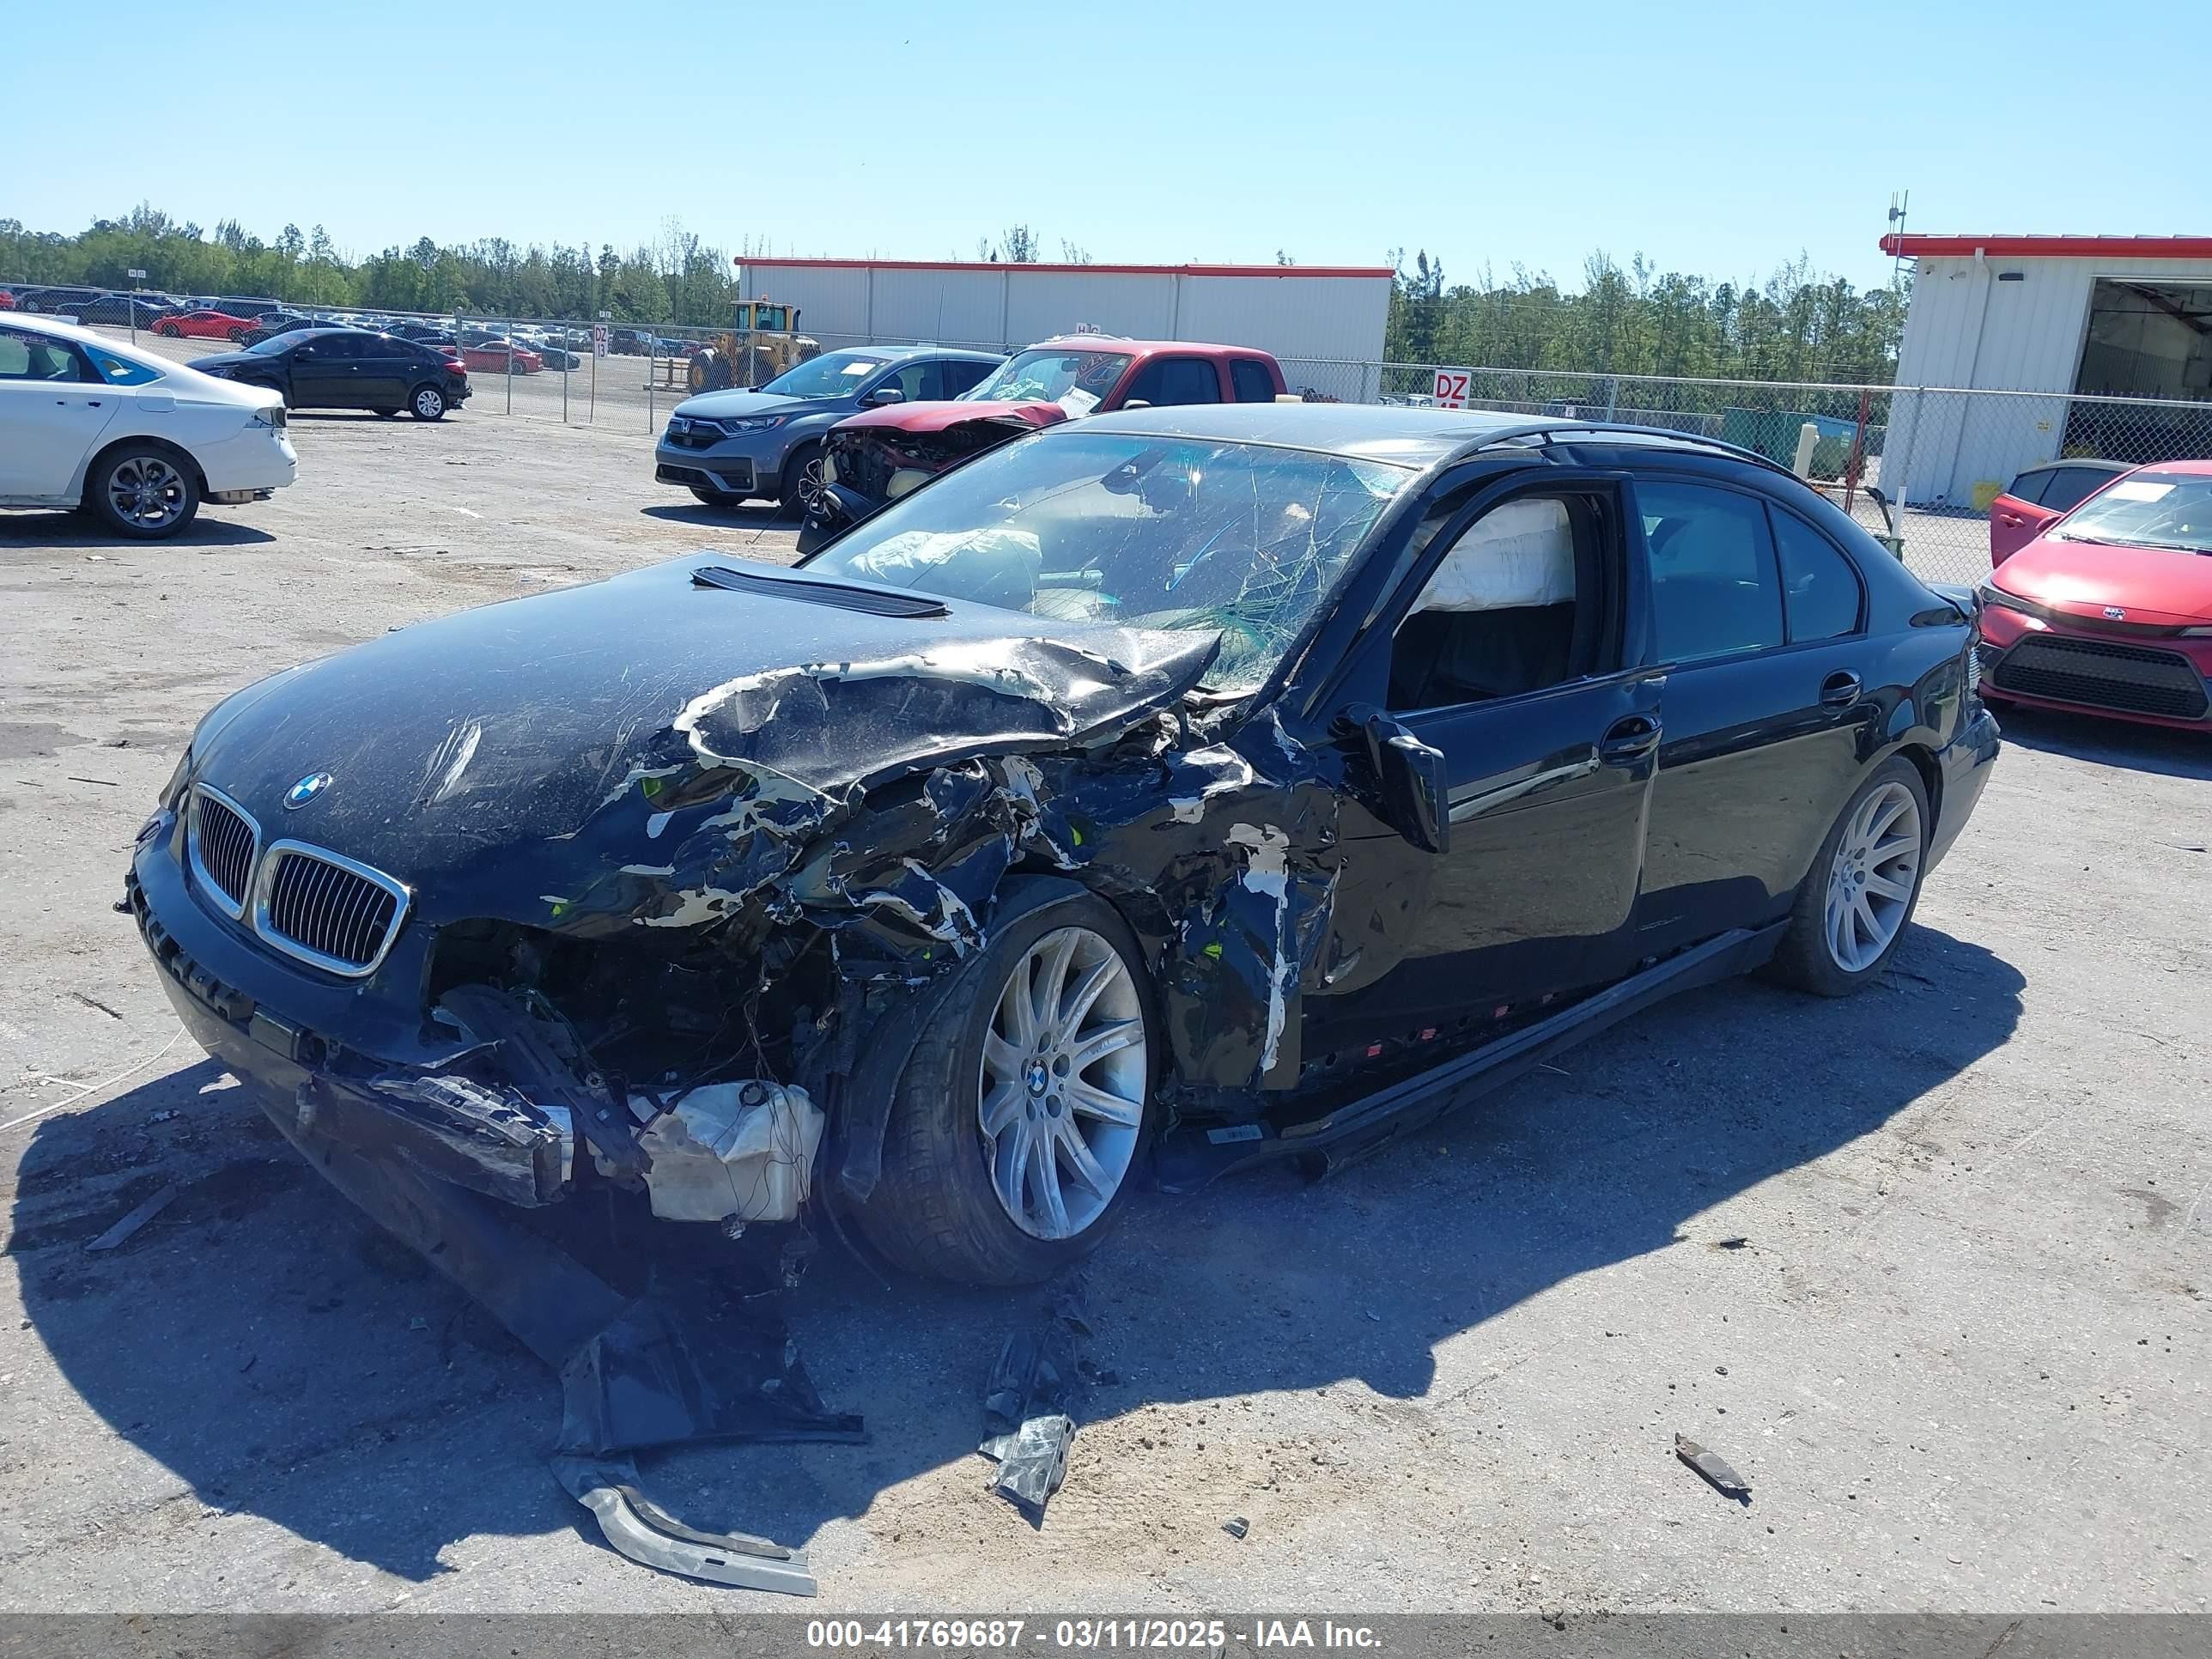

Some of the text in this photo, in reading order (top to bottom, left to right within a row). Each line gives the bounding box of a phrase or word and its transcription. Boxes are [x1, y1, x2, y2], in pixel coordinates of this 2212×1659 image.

[595, 327, 606, 342] DZ
[598, 343, 605, 357] 13
[1436, 374, 1468, 400] DZ
